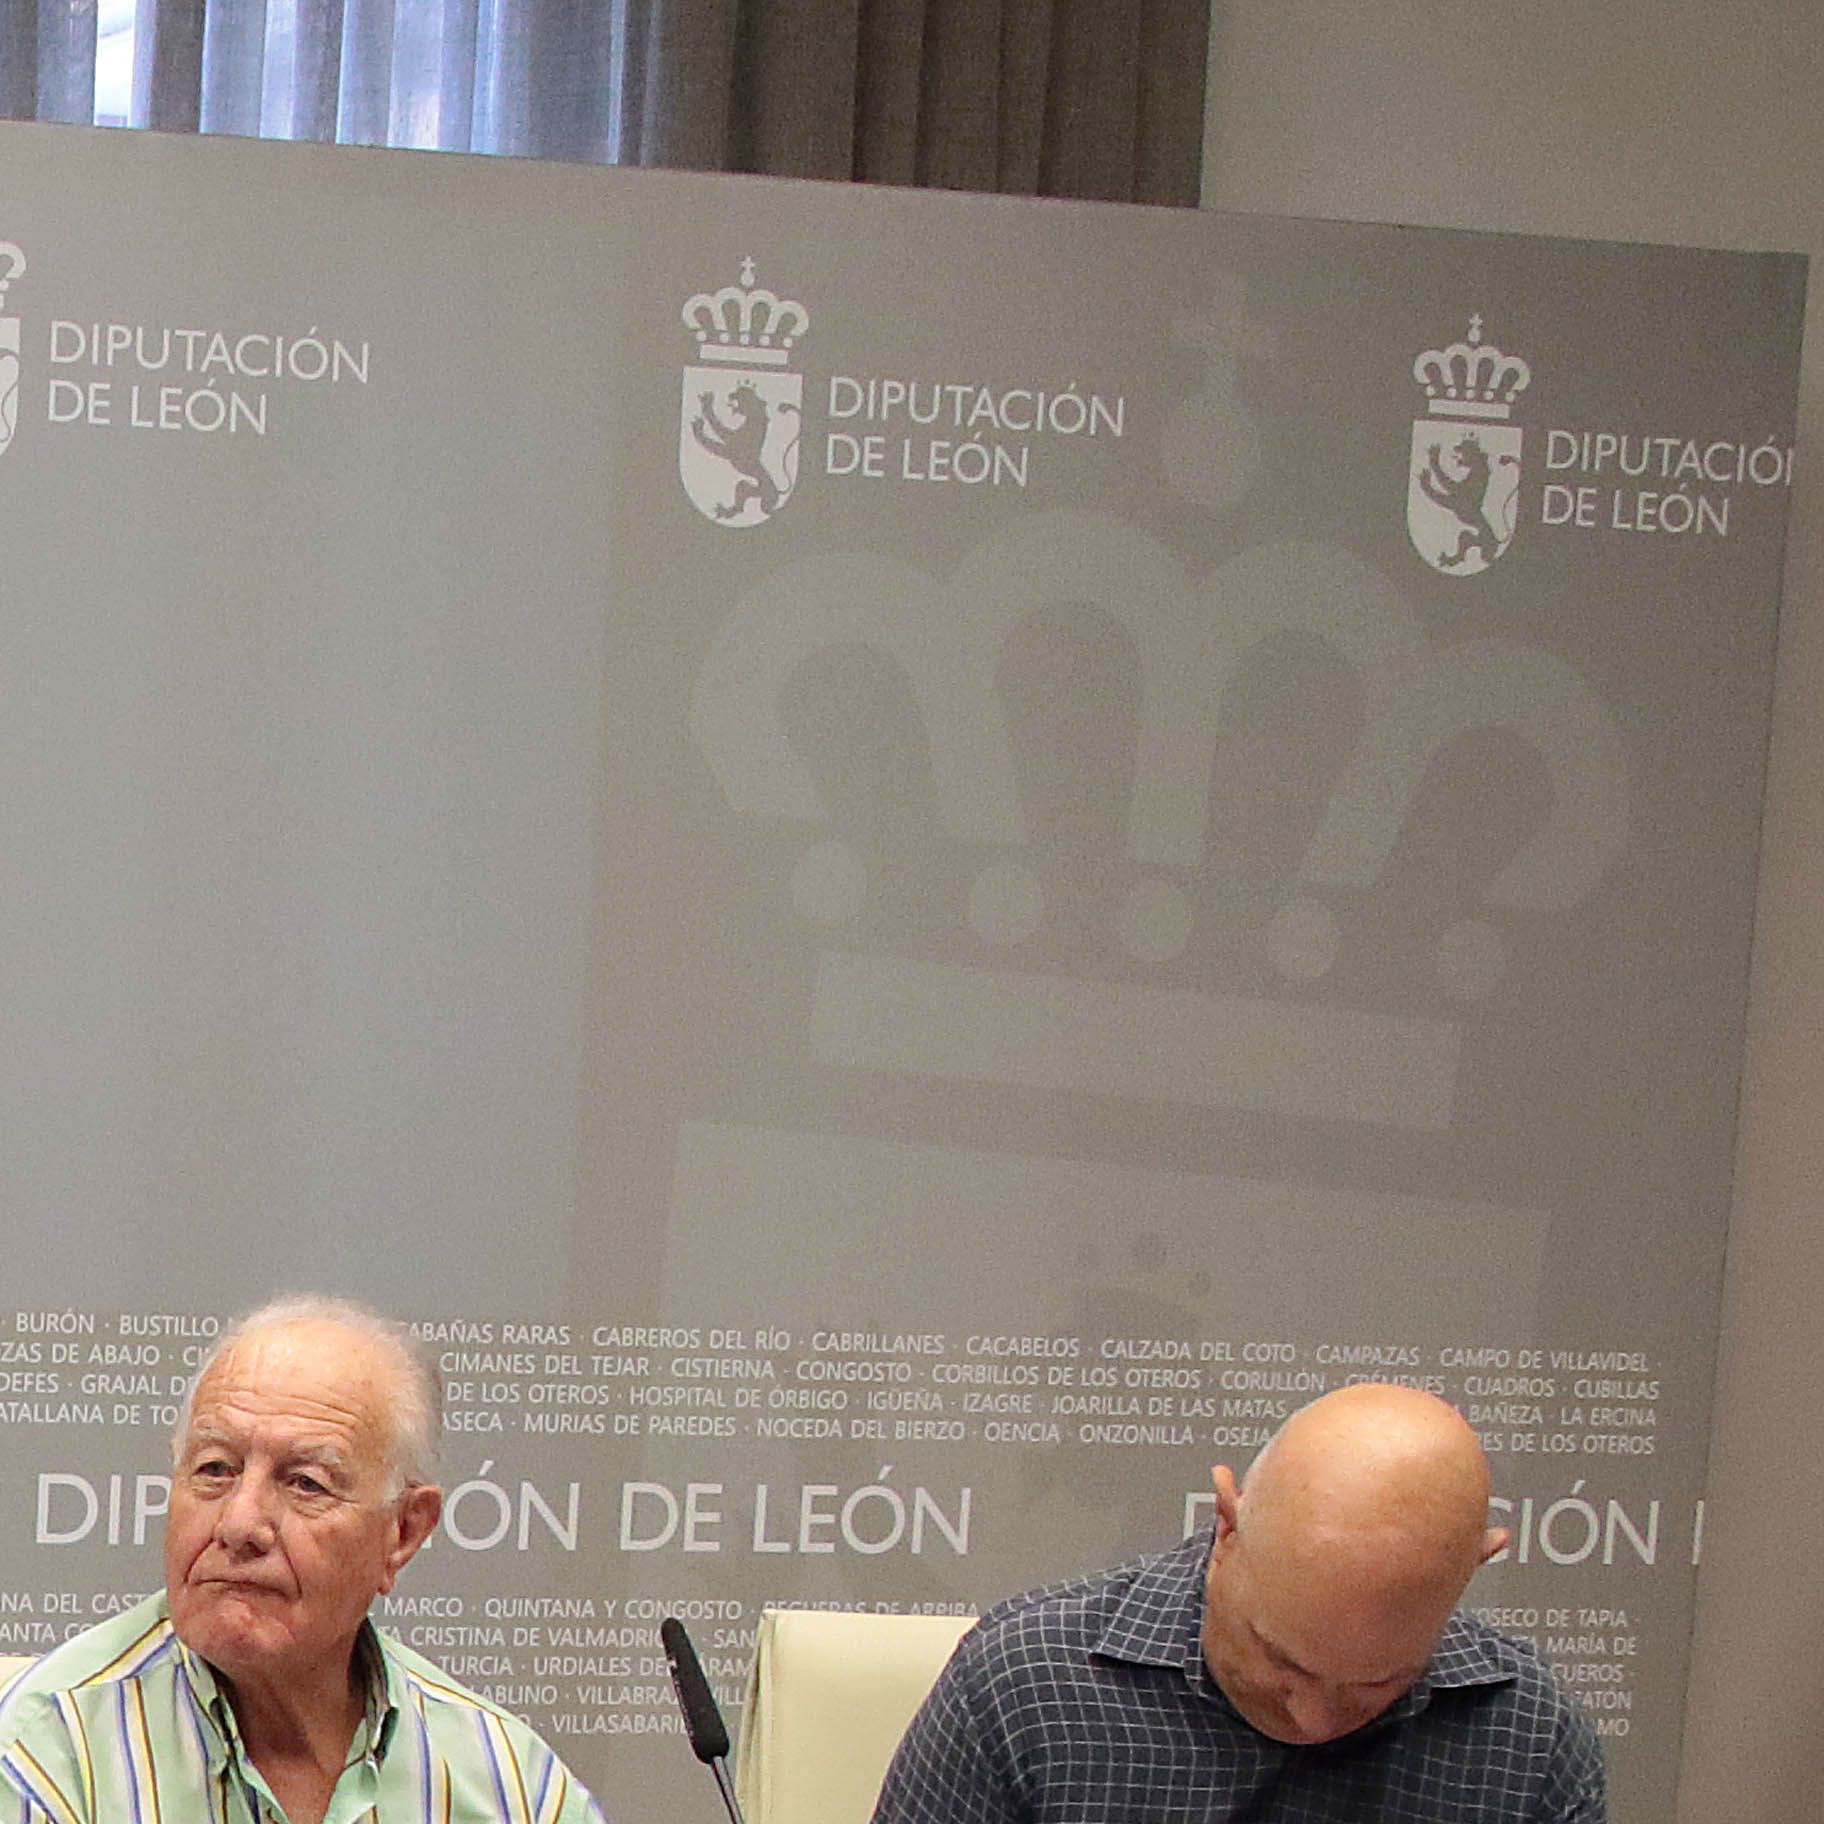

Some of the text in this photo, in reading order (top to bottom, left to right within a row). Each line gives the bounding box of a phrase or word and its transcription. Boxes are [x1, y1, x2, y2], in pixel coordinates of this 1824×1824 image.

[51, 321, 368, 383] DIPUTACIÓN
[49, 378, 266, 434] DE LEÓN
[830, 377, 1124, 436] DIPUTACIÓN
[827, 432, 1028, 486] DE LEÓN
[1547, 430, 1794, 484] DIPUTACIÓ
[1542, 483, 1728, 535] DE LEÓN
[16, 1307, 95, 1334] BURÓN
[592, 1324, 945, 1355] CABREROS DEL RÍO CABRILLANES
[670, 1357, 912, 1383] CISTIERNA CONGOSTO
[1220, 1368, 1325, 1392] CORULLÓN
[629, 1384, 849, 1411] HOSPITAL DE ÓRBIGO
[1463, 1375, 1660, 1401] CUADROS CUBILLAS
[756, 1417, 966, 1441] NOCEDA DEL BIERZO
[1079, 1423, 1195, 1446] ONZONILLA
[621, 1482, 722, 1551] DE
[754, 1465, 971, 1554] LEÓN
[484, 1597, 743, 1621] QUINTANA Y CONGOSTO
